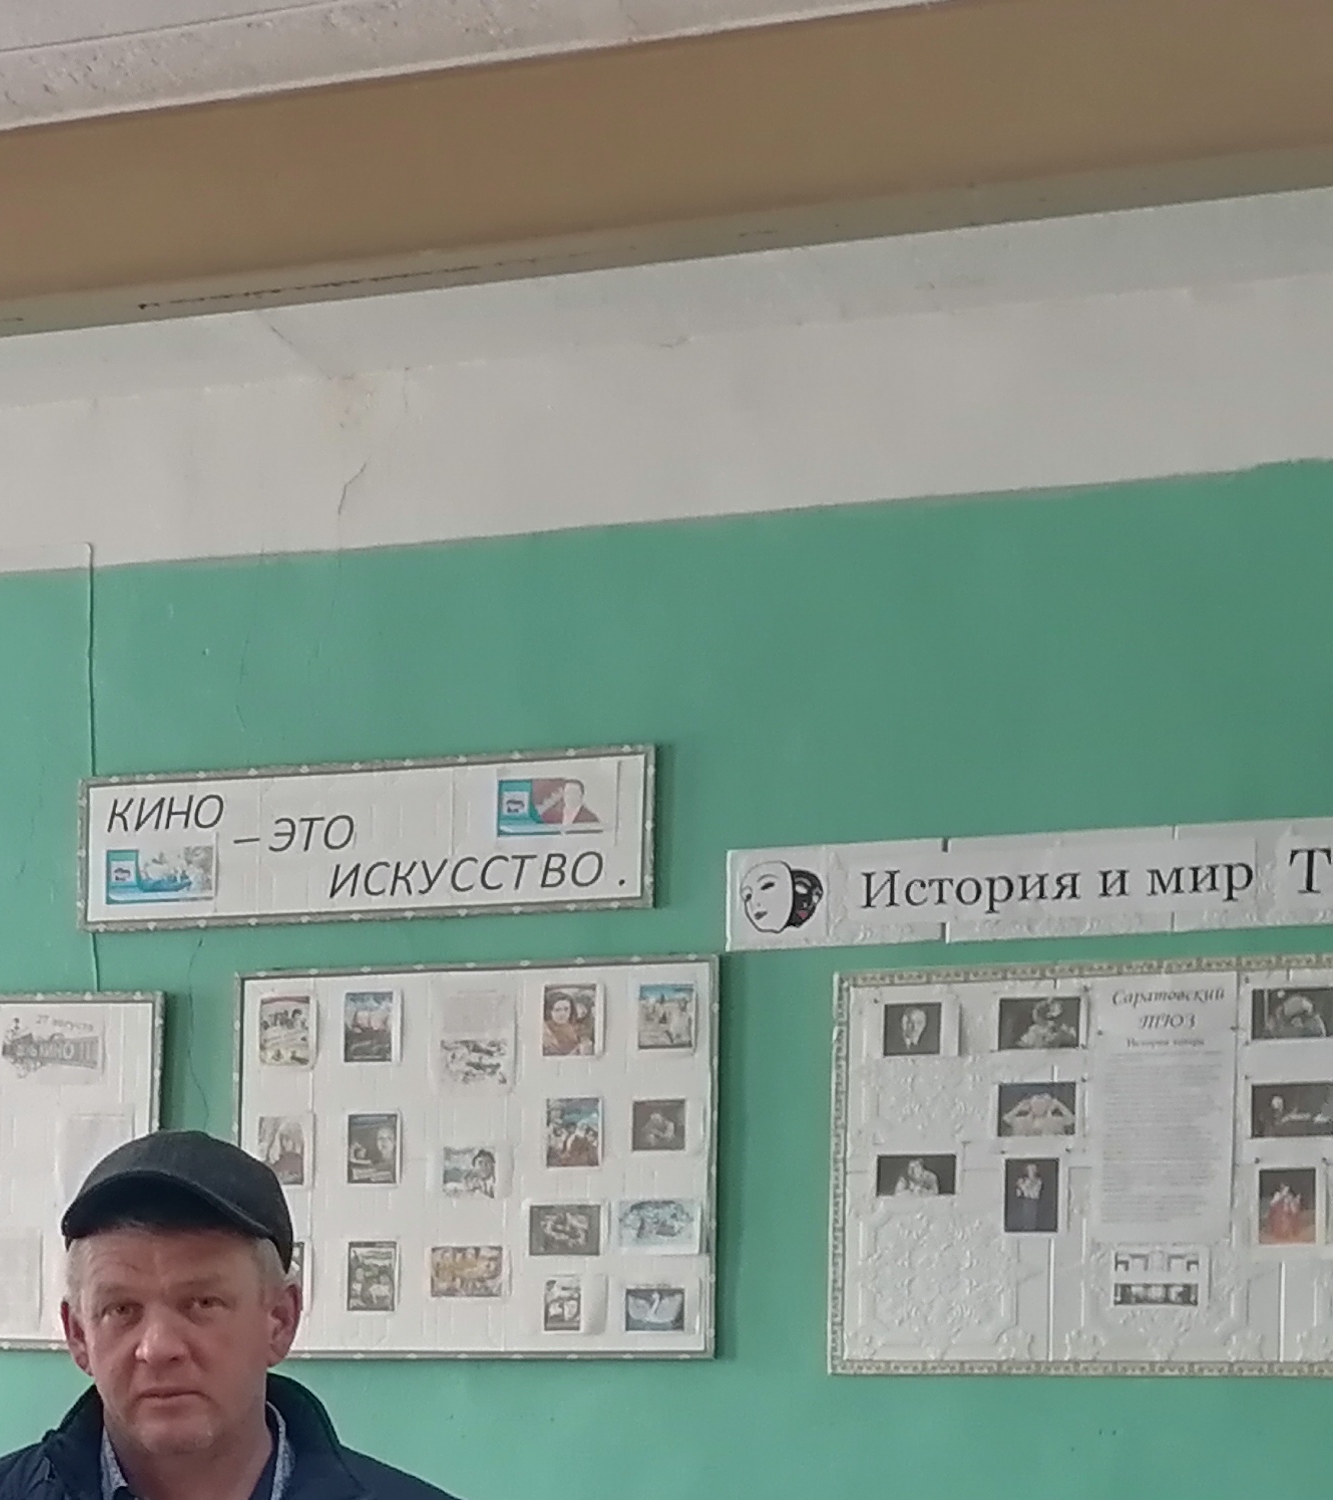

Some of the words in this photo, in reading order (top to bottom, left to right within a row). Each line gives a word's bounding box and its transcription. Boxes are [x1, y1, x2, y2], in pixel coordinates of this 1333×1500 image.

[107, 794, 223, 833] КИНО
[269, 815, 355, 852] ЭТО
[860, 869, 1081, 914] История
[1098, 869, 1129, 896] и
[1147, 862, 1254, 902] мир
